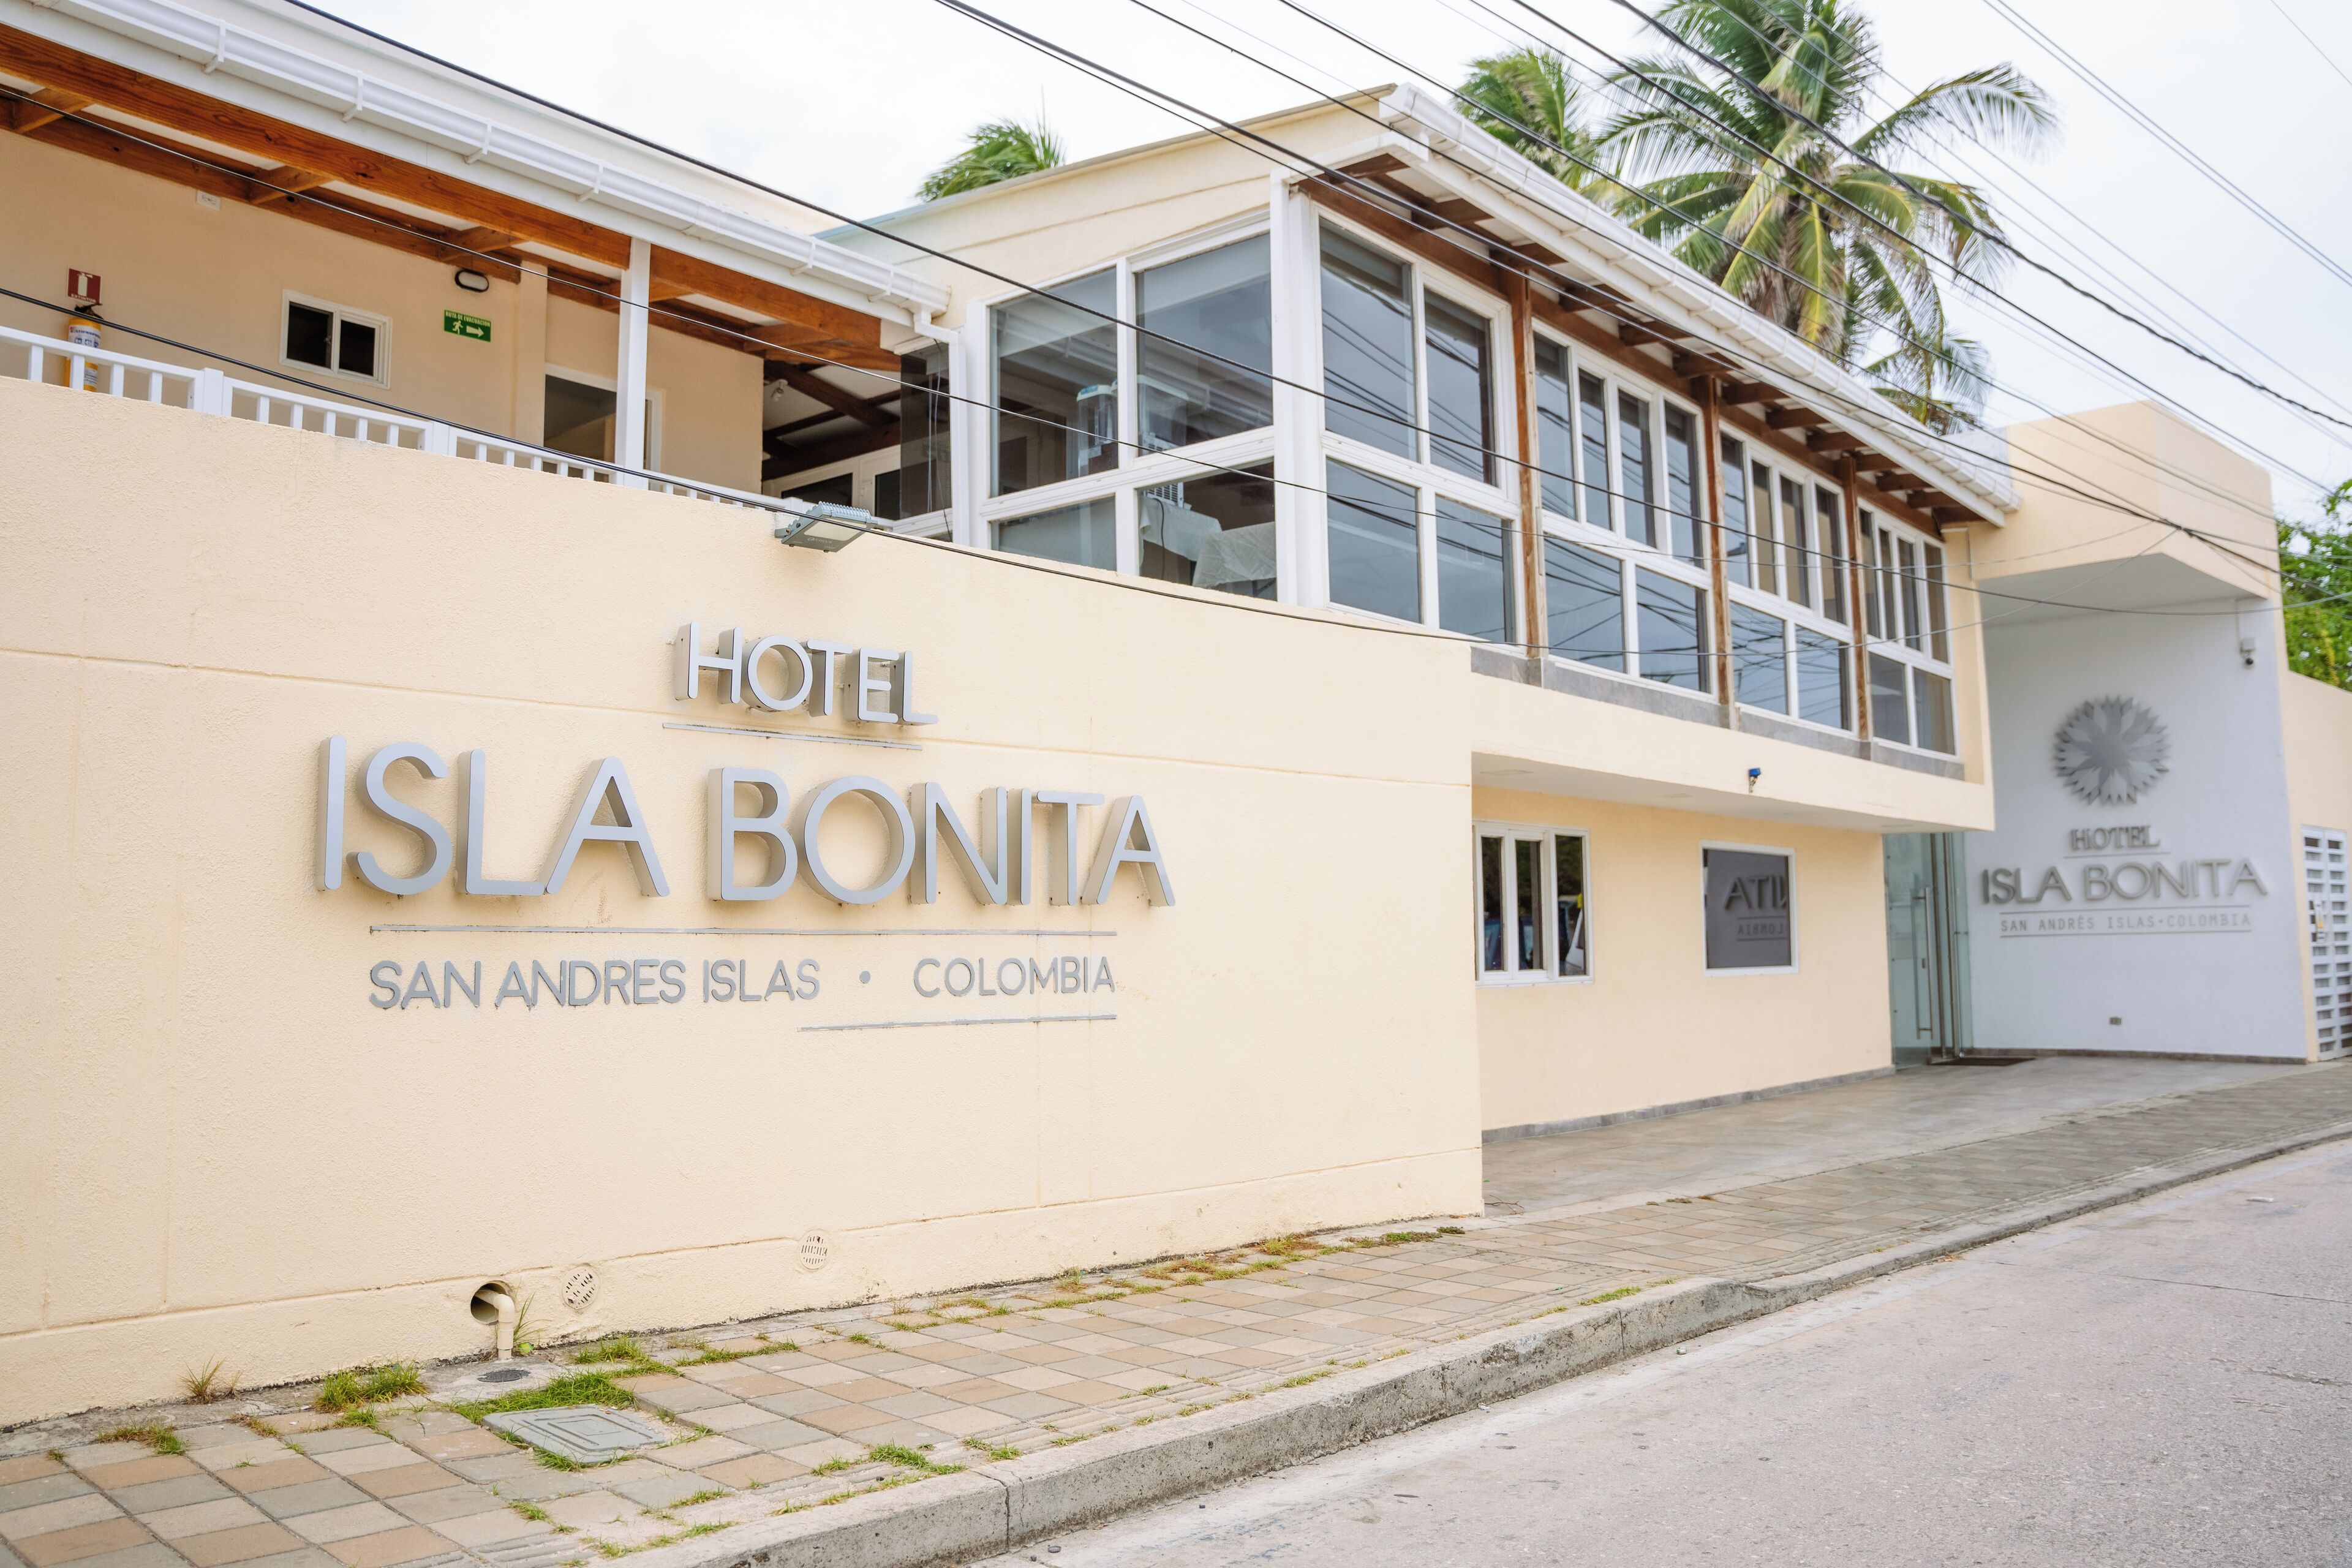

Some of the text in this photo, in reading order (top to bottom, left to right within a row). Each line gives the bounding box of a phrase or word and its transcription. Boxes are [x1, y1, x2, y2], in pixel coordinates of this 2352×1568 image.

[445, 311, 457, 319] RUTA
[674, 621, 938, 725] HOTEL
[316, 736, 1176, 907] ISLA BONITA
[2070, 825, 2160, 850] HOTEL
[1982, 859, 2269, 904] ISLA BONITA
[2000, 919, 2028, 932] SAN
[2038, 915, 2095, 930] ANDRÉS
[369, 956, 1117, 1009] SAN ANDRES ISLAS COLOMBIA
